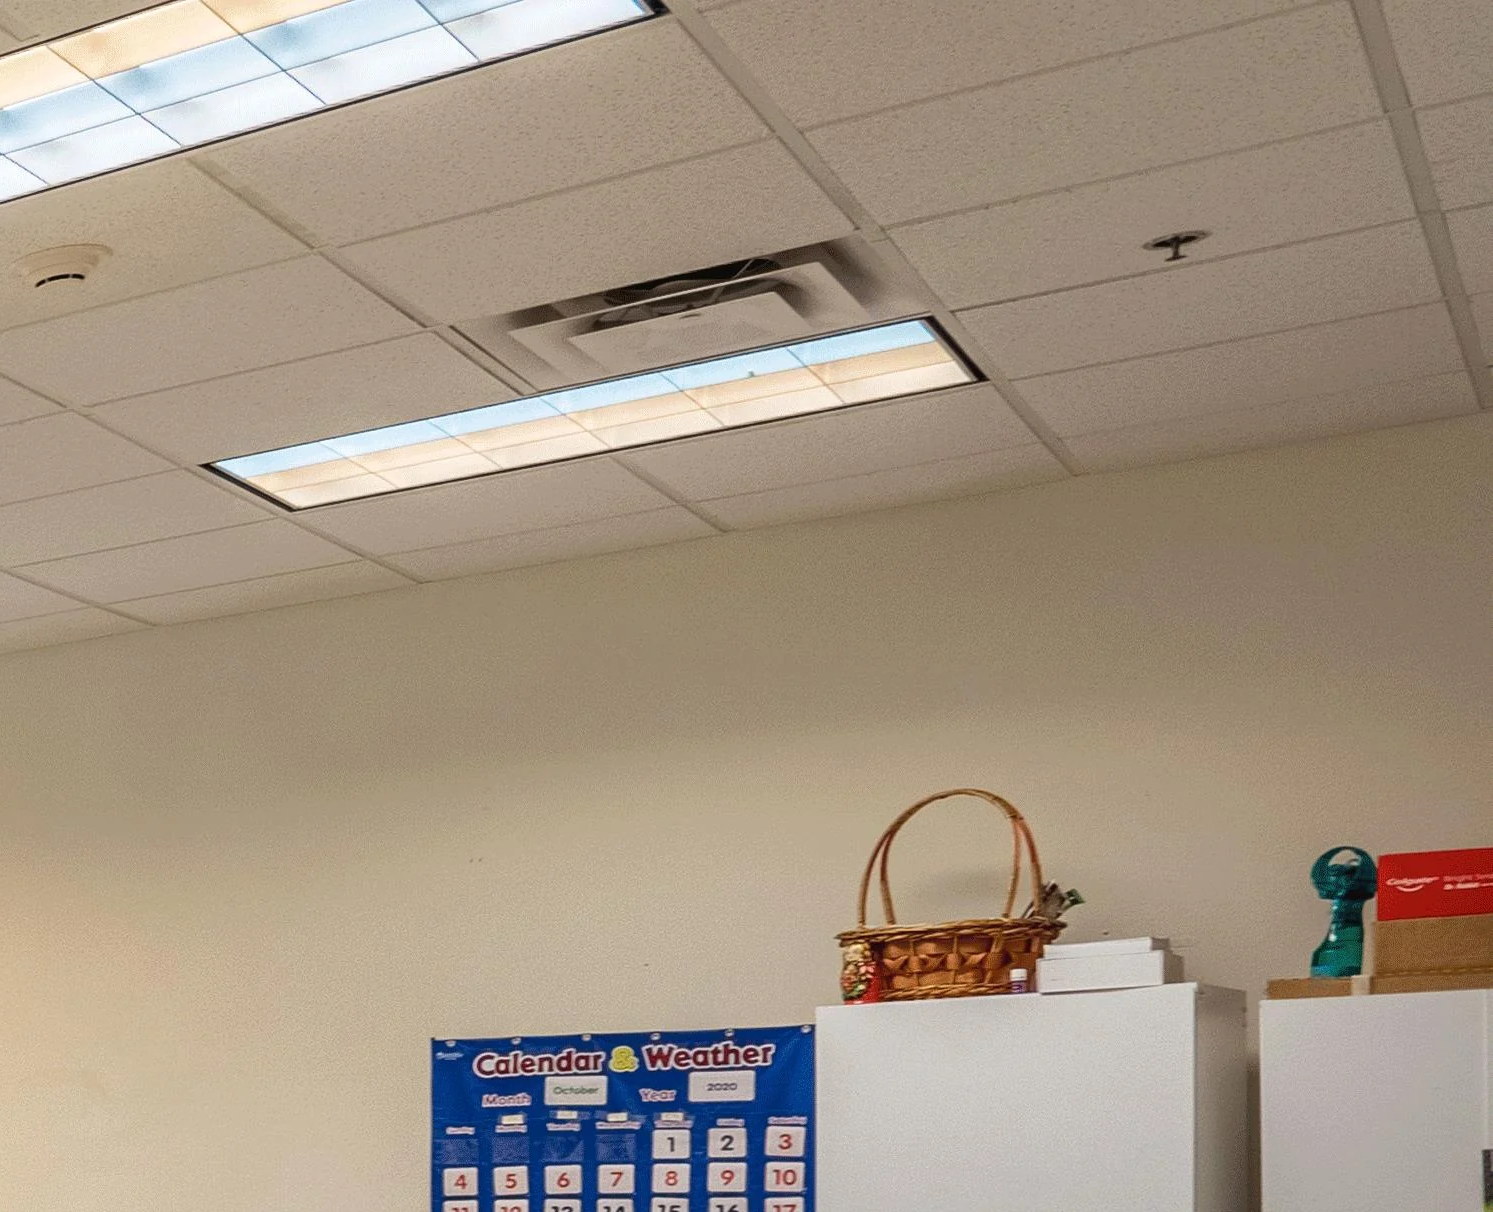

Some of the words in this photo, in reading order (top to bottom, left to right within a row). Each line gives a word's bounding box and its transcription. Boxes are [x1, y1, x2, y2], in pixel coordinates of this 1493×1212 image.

[475, 1049, 604, 1077] Calendar
[610, 1046, 638, 1071] &
[644, 1043, 774, 1070] Weather
[553, 1086, 599, 1095] October
[707, 1083, 737, 1091] 2020
[483, 1094, 531, 1106] Month
[639, 1089, 676, 1101] Year
[667, 1137, 675, 1151] 1
[721, 1136, 734, 1150] 2
[778, 1135, 792, 1149] 3
[454, 1175, 467, 1189] 4
[505, 1174, 517, 1188] 5
[557, 1173, 570, 1187] 6
[610, 1172, 623, 1186] 7
[665, 1171, 678, 1185] 8
[721, 1171, 734, 1185] 9
[773, 1169, 797, 1185] 10
